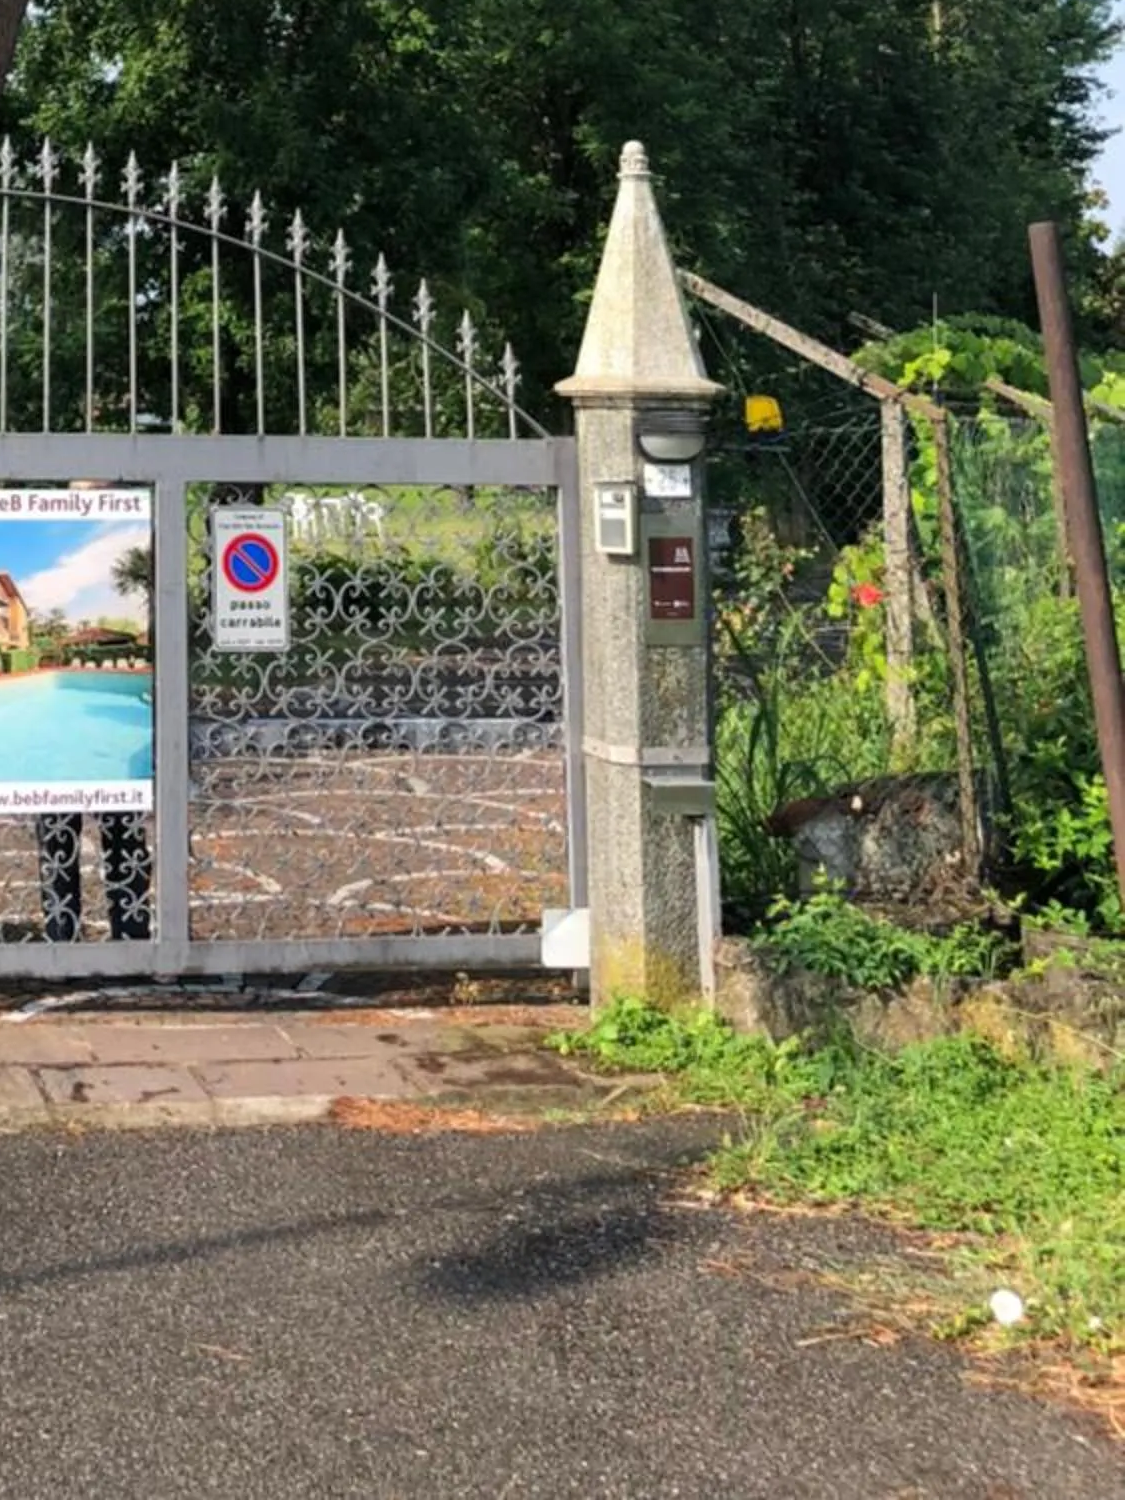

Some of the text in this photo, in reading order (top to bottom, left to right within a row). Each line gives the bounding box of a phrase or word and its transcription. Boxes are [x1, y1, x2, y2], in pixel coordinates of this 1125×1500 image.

[28, 493, 92, 516] Family
[98, 493, 142, 512] First
[230, 600, 271, 612] passo
[220, 615, 282, 628] carrabile
